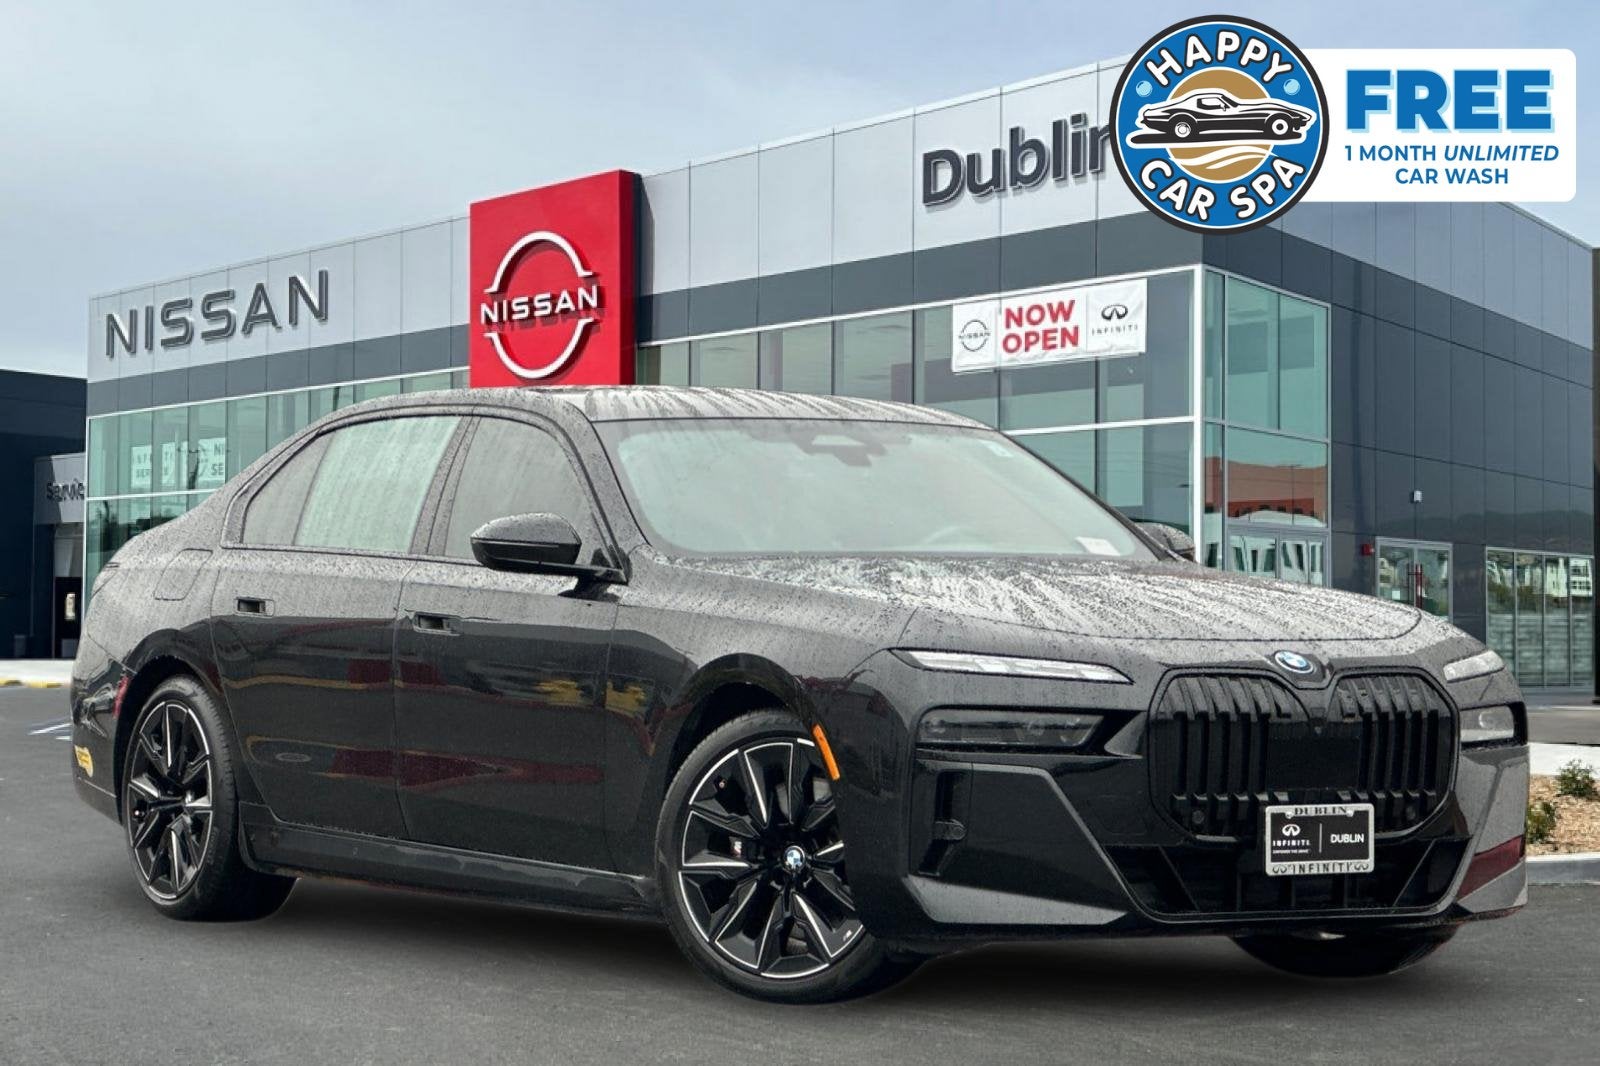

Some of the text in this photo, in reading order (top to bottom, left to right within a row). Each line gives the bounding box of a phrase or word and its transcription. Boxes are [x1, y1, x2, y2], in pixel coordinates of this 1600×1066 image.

[106, 269, 329, 358] NISSAN
[480, 284, 598, 325] NISSAN
[1005, 300, 1076, 330] NOW
[1002, 325, 1079, 353] OPEN
[1295, 807, 1347, 815] DUBLIN
[1330, 834, 1364, 843] DUBLIN
